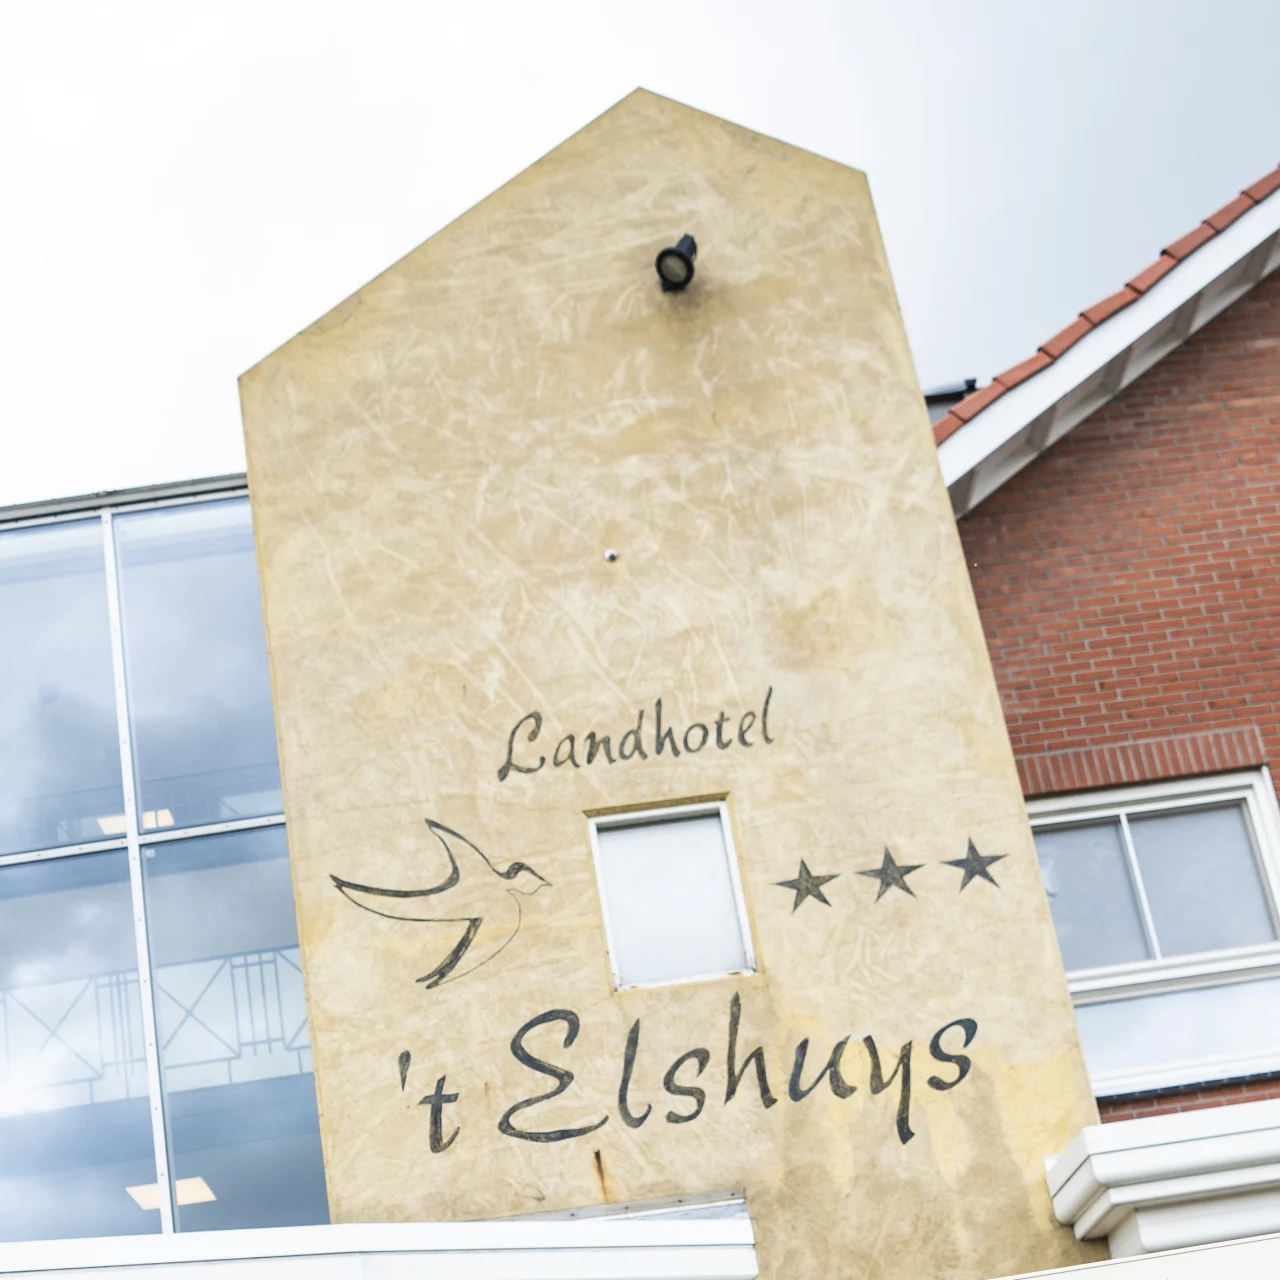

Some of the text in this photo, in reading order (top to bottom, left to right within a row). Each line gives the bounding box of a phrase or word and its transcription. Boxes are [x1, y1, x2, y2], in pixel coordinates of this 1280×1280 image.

[496, 685, 776, 782] Landhotel
[396, 990, 979, 1154] 't Elshuys
